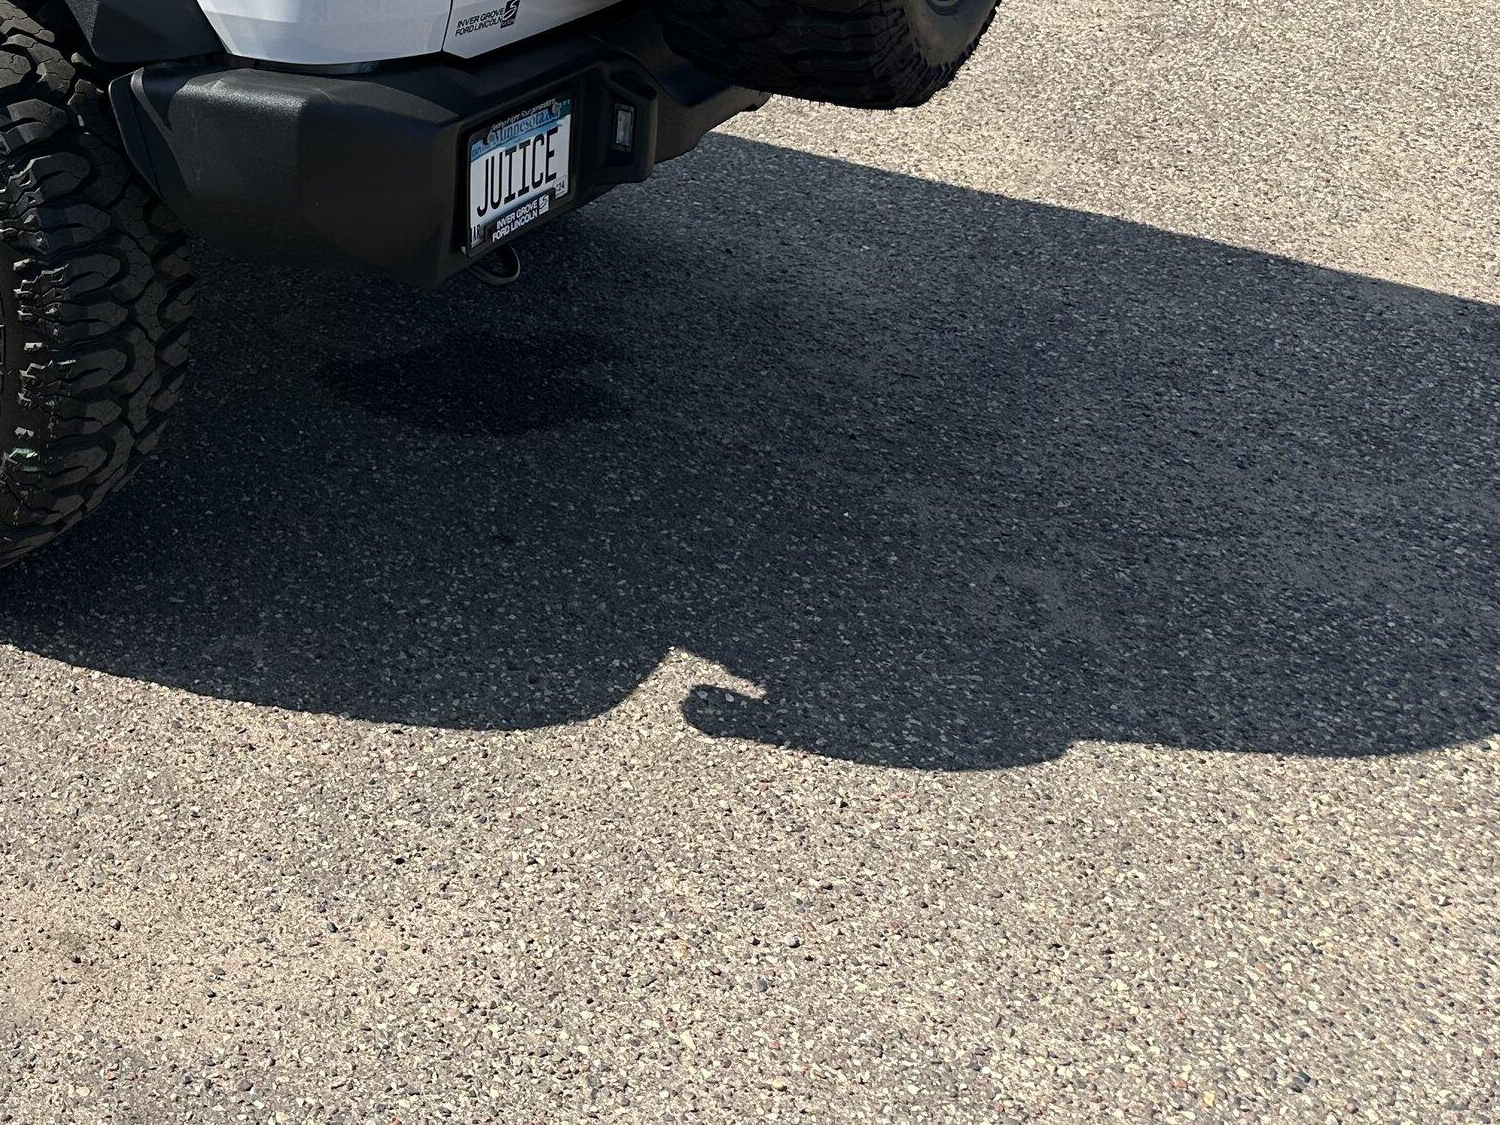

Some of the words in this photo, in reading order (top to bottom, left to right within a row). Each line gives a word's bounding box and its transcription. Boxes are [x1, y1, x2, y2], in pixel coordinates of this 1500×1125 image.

[455, 25, 475, 37] FORD
[474, 16, 503, 31] LINCOLN
[456, 15, 480, 28] INVER
[479, 7, 504, 22] GROVE
[477, 126, 558, 217] JUIICE
[492, 225, 510, 242] FORD
[510, 209, 538, 232] LINCOLN
[496, 212, 515, 230] INVER
[516, 199, 538, 219] GROVE
